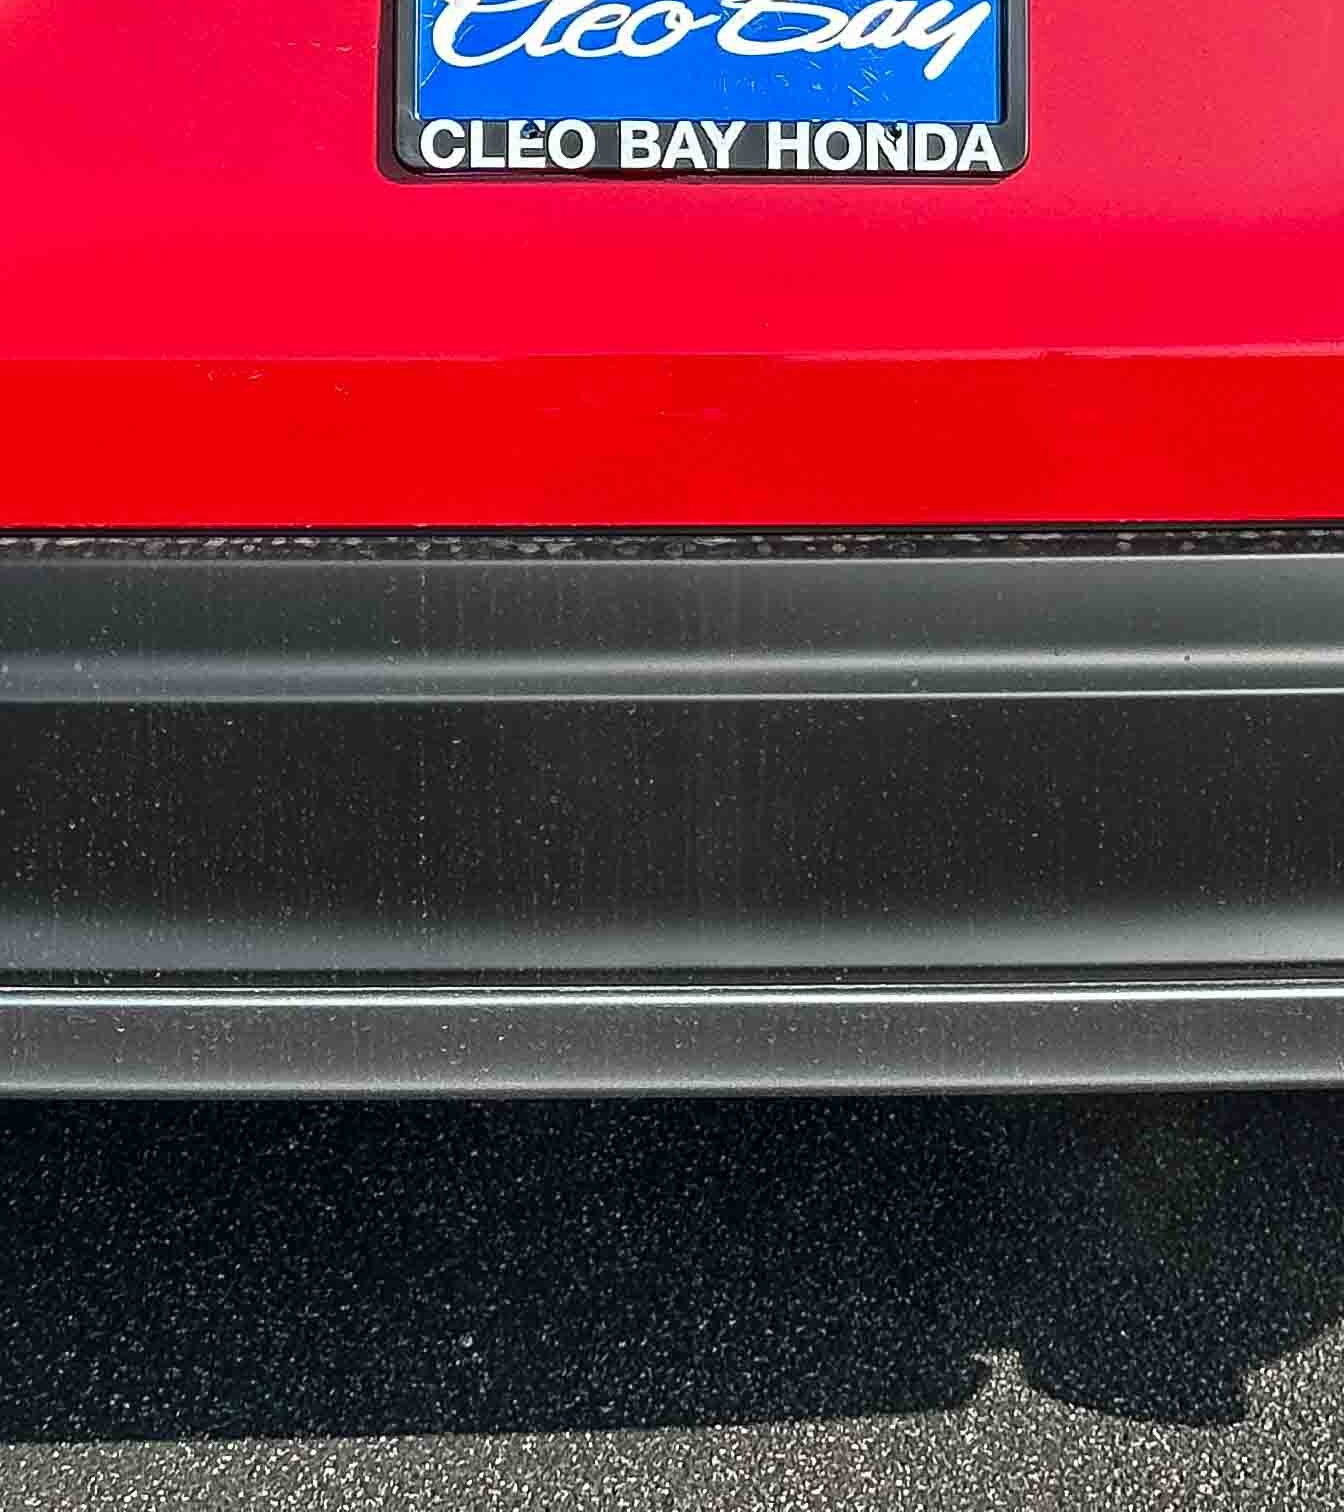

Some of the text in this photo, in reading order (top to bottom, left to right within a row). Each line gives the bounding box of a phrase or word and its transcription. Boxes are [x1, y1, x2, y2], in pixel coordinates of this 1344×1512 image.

[419, 118, 1002, 172] CLEO BAY HONDA
